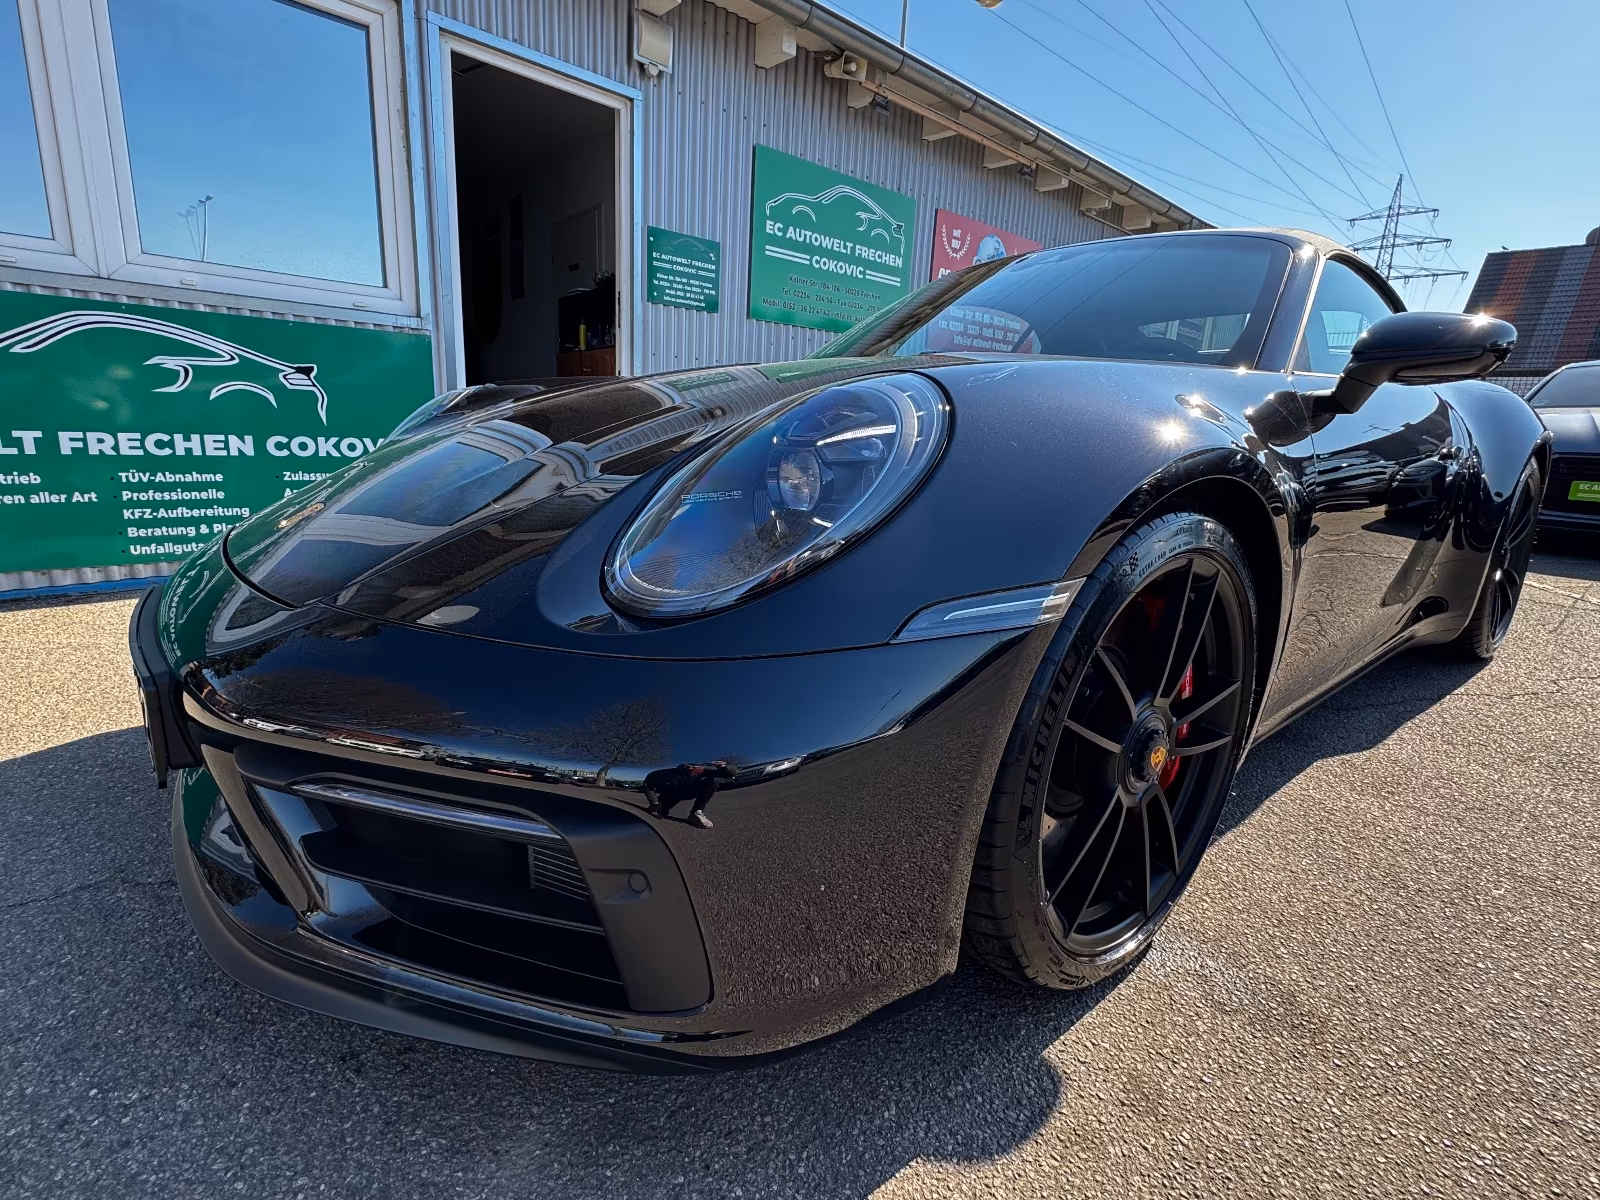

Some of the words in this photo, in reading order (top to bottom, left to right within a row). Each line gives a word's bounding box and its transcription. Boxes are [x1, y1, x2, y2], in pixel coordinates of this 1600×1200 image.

[766, 220, 783, 236] EC
[786, 226, 854, 254] AUTOWELT
[855, 244, 902, 268] FRECHEN
[661, 254, 691, 264] AUTOWELT
[692, 261, 716, 270] FRECHEN
[812, 256, 864, 278] COKOVIC
[673, 265, 697, 274] COKOVIC
[762, 298, 780, 308] Mobil.
[783, 301, 796, 310] 0152
[57, 431, 255, 456] FRECHEN
[118, 469, 224, 483] TÜV-Abnahme
[30, 492, 68, 504] aller
[72, 492, 98, 503] Art
[122, 488, 225, 501] Professionelle
[681, 490, 743, 500] PORSCHE
[123, 505, 250, 519] KFZ-Aufbereitung
[127, 526, 196, 537] Beratung
[199, 524, 209, 534] &
[1138, 562, 1154, 578] EXTRA
[1022, 651, 1078, 812] MICHELIN
